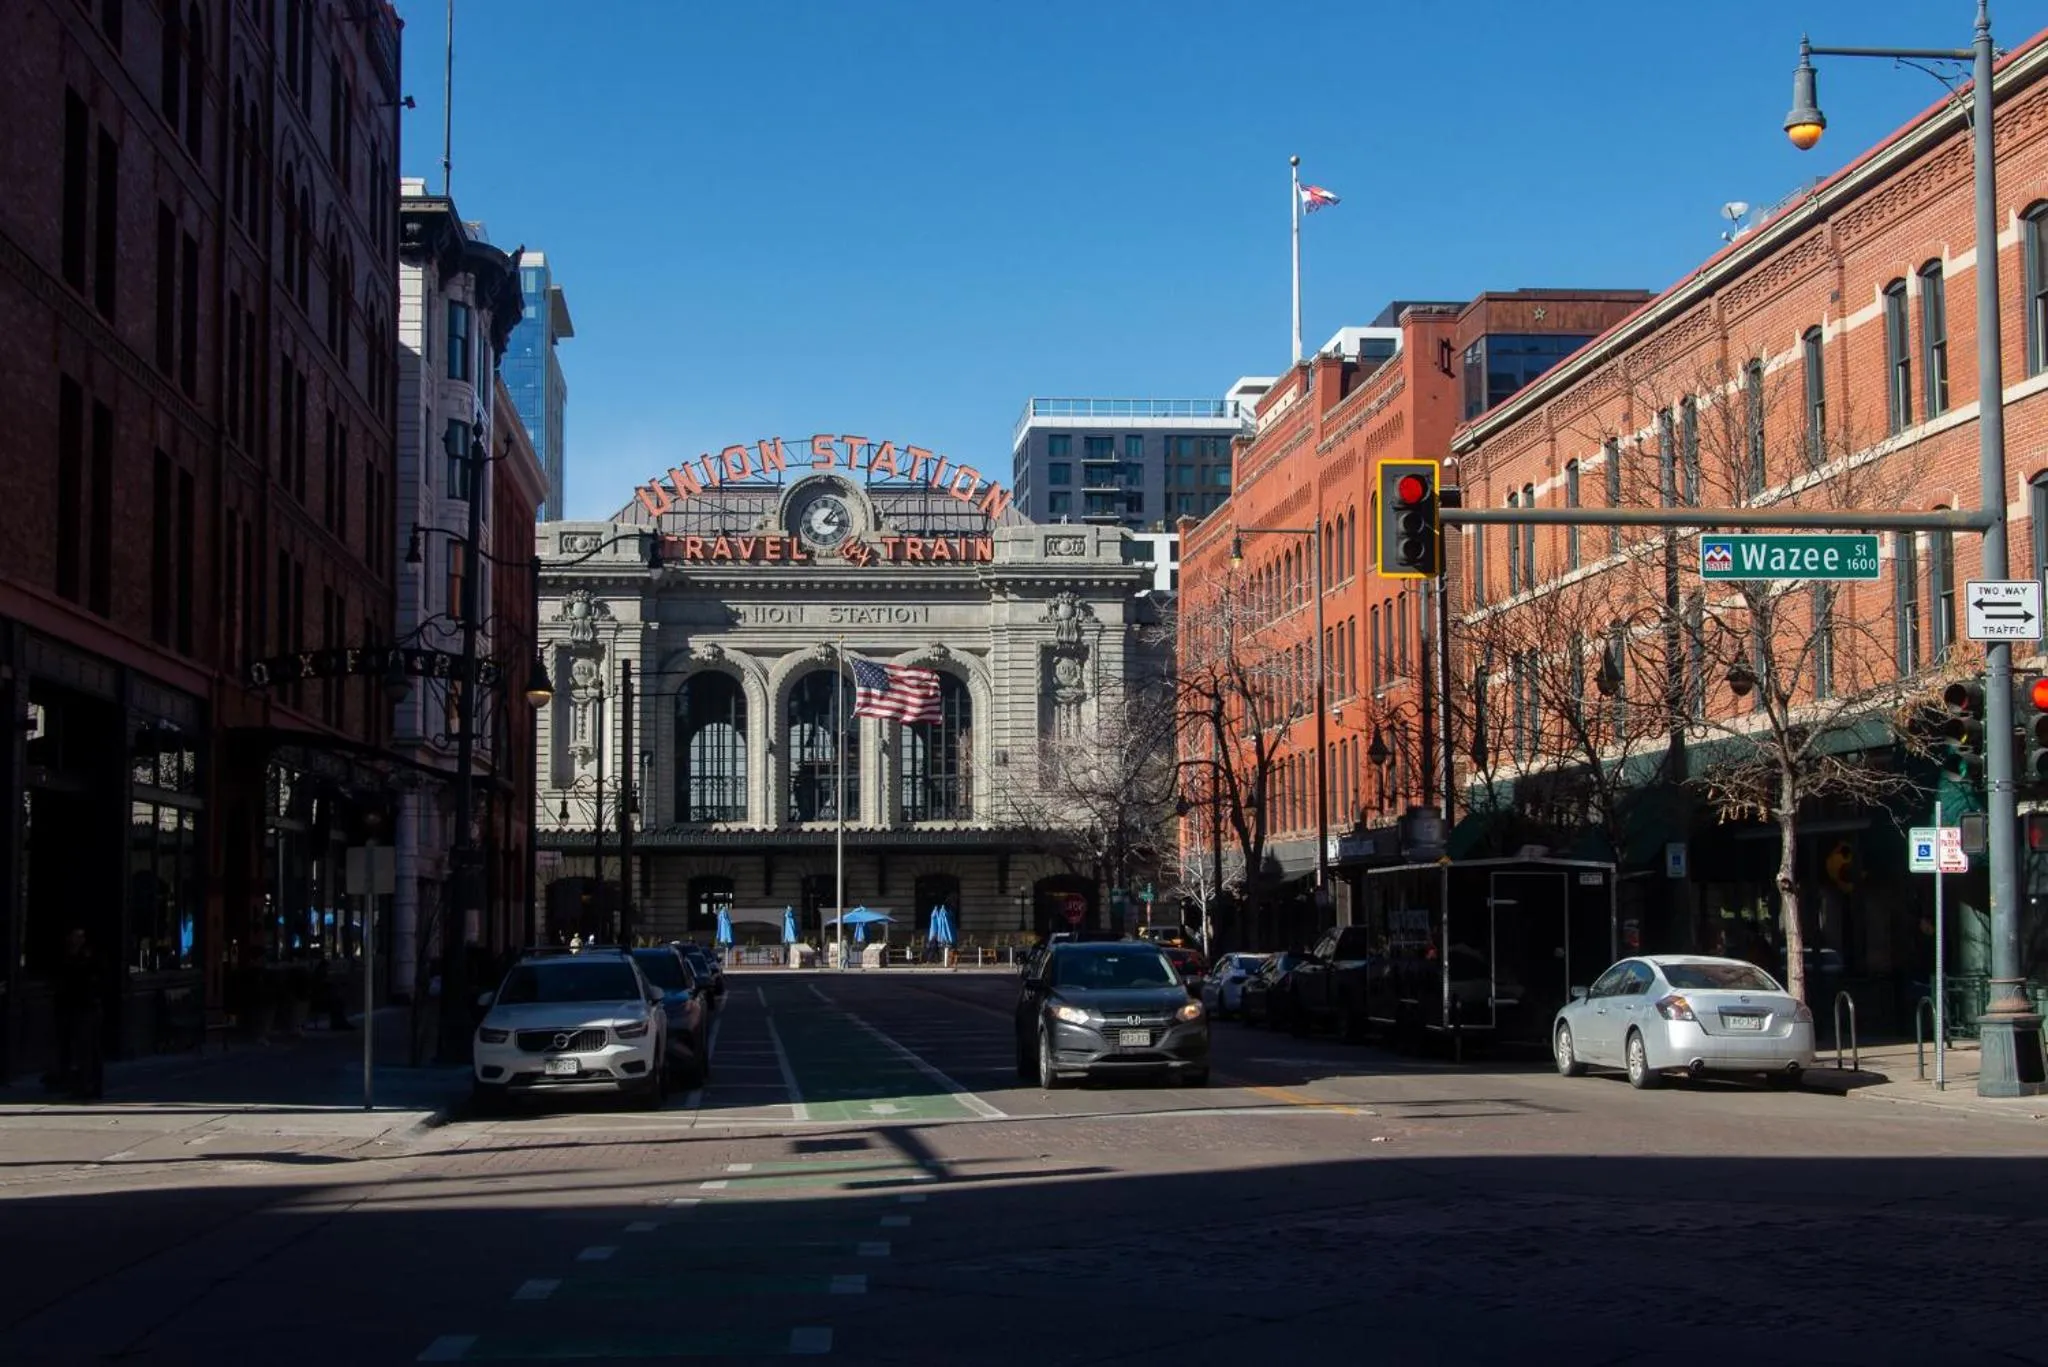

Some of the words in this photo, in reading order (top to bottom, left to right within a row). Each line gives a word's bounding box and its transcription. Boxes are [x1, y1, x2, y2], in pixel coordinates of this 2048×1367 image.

[634, 437, 786, 517] UNION
[811, 434, 1013, 520] STATION
[661, 536, 808, 560] TRAVEL
[836, 536, 871, 568] by
[881, 536, 994, 561] TRAIN
[1740, 543, 1839, 571] Wazee
[1854, 544, 1867, 556] St
[1847, 558, 1877, 570] 1600
[1978, 586, 2000, 596] TWO
[2005, 586, 2028, 596] WAY
[828, 606, 929, 624] STATION
[1983, 625, 2026, 635] TRAFFIC
